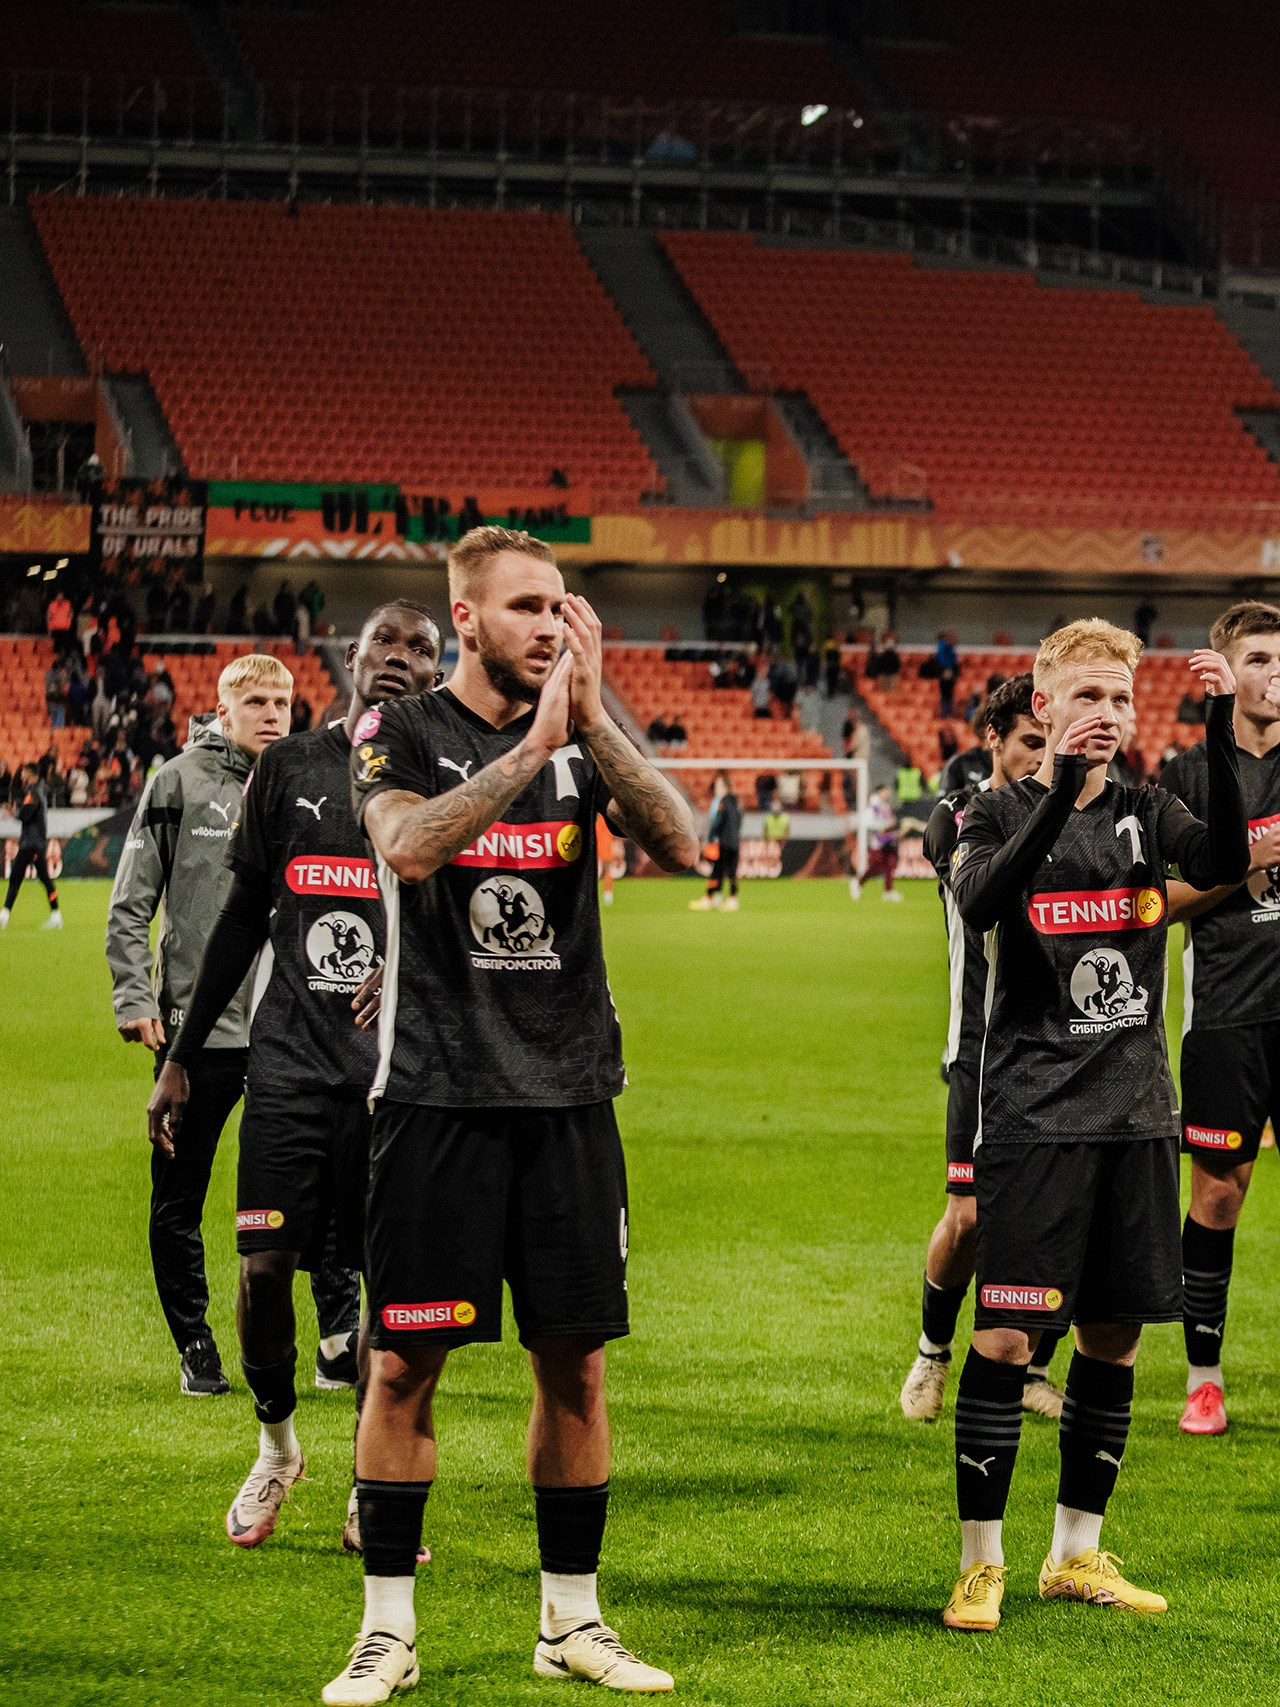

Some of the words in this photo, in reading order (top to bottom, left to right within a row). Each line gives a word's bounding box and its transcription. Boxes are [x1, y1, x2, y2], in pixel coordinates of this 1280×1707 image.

[101, 504, 140, 528] THE
[145, 504, 203, 528] PRIDE
[102, 535, 128, 558] OF
[134, 535, 199, 558] URALS
[461, 832, 553, 859] NNISI
[294, 864, 380, 890] TENNI
[1033, 897, 1136, 925] TENNISI
[1138, 896, 1159, 915] bet
[470, 957, 562, 971] СИБПРОМСТРОЙ
[1069, 1015, 1148, 1035] СИБПРОМСТРОЙ
[1187, 1127, 1225, 1146] TENNISI
[983, 1288, 1043, 1306] TENNISI
[386, 1307, 451, 1324] TENNISI
